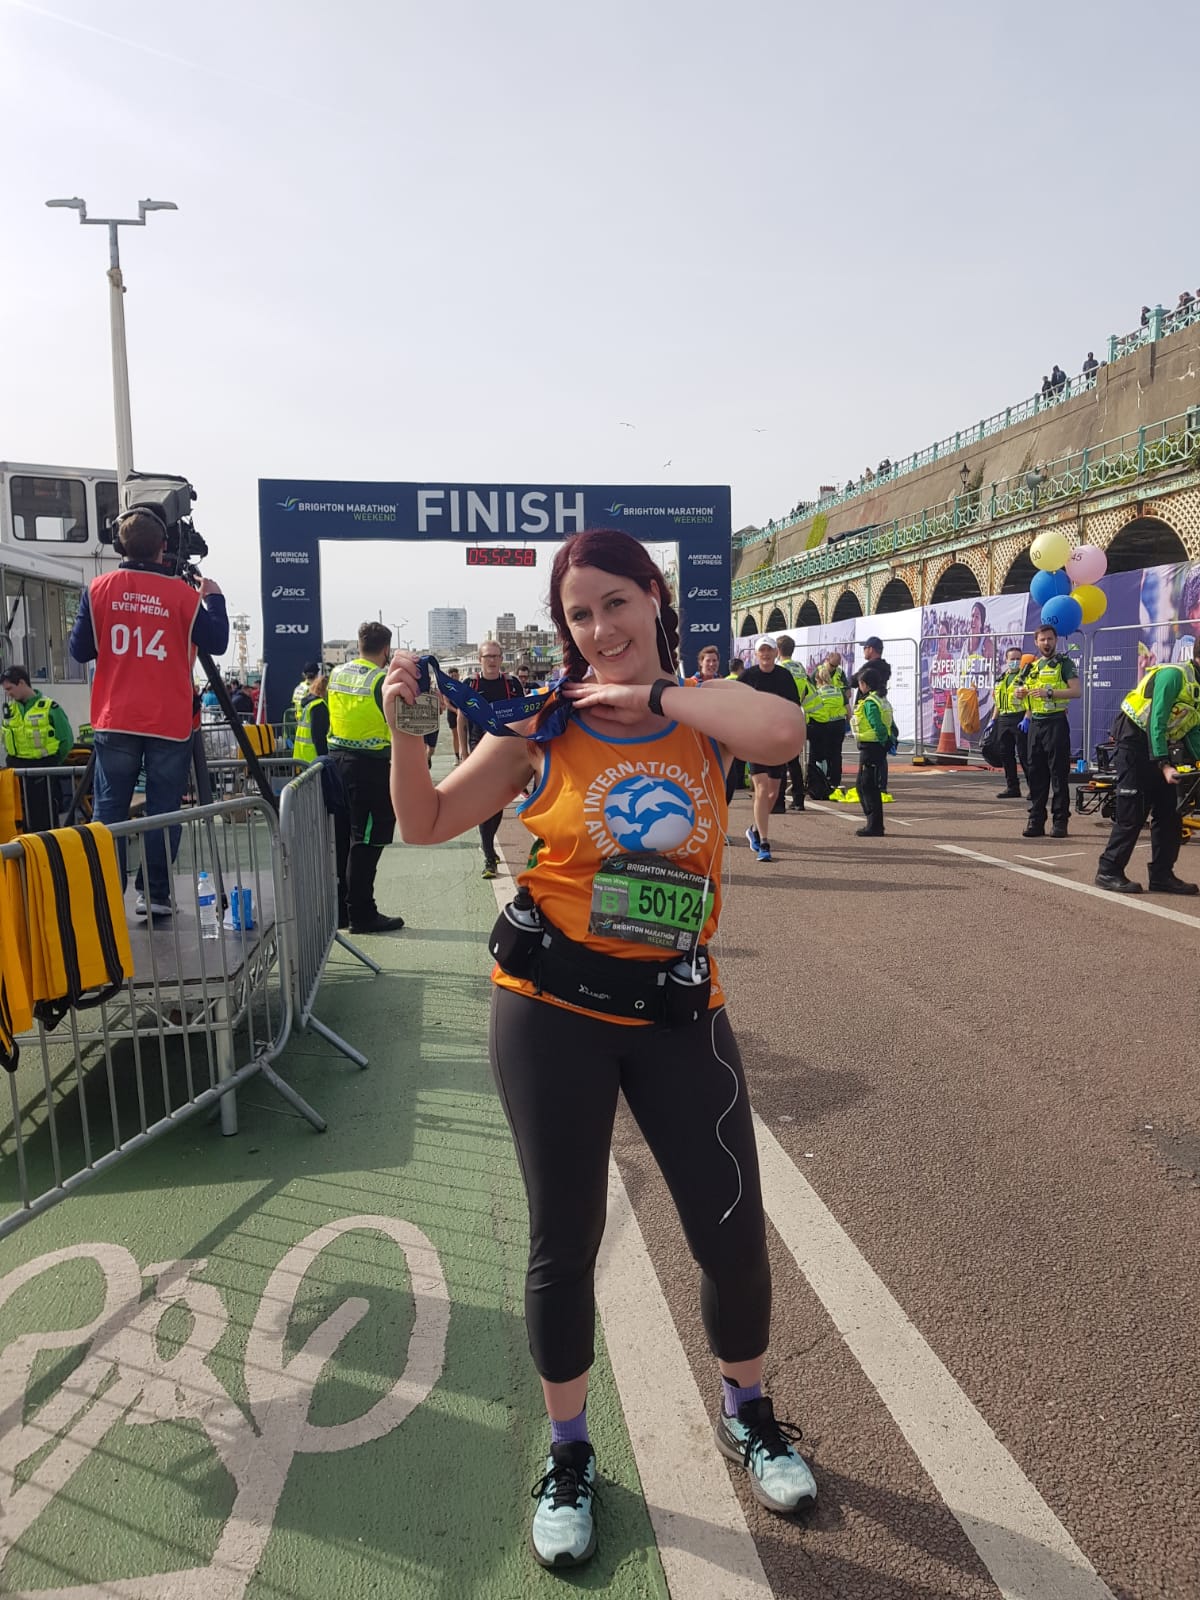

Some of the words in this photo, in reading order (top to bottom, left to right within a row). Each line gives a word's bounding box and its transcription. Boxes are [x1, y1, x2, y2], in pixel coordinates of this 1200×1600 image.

[298, 502, 345, 513] BRIGHTON
[347, 503, 397, 513] MARATHON
[417, 490, 585, 534] FINISH
[623, 507, 665, 516] BRIGHTON
[667, 507, 713, 516] MARATHON
[353, 513, 397, 521] WEEKEND
[674, 516, 713, 524] WEEKEND
[282, 586, 306, 597] asics
[697, 588, 719, 597] asics
[140, 604, 170, 618] MEDIA
[275, 623, 310, 634] 2XU
[689, 623, 721, 633] 2XU
[110, 623, 168, 662] 014
[583, 760, 709, 813] INTERNATIONAL
[661, 816, 712, 861] ESCUE
[626, 863, 667, 877] BRIGHTON
[601, 891, 619, 913] B
[638, 885, 705, 927] 50124
[612, 924, 644, 935] BRIGHTON
[644, 928, 676, 941] MARATHON
